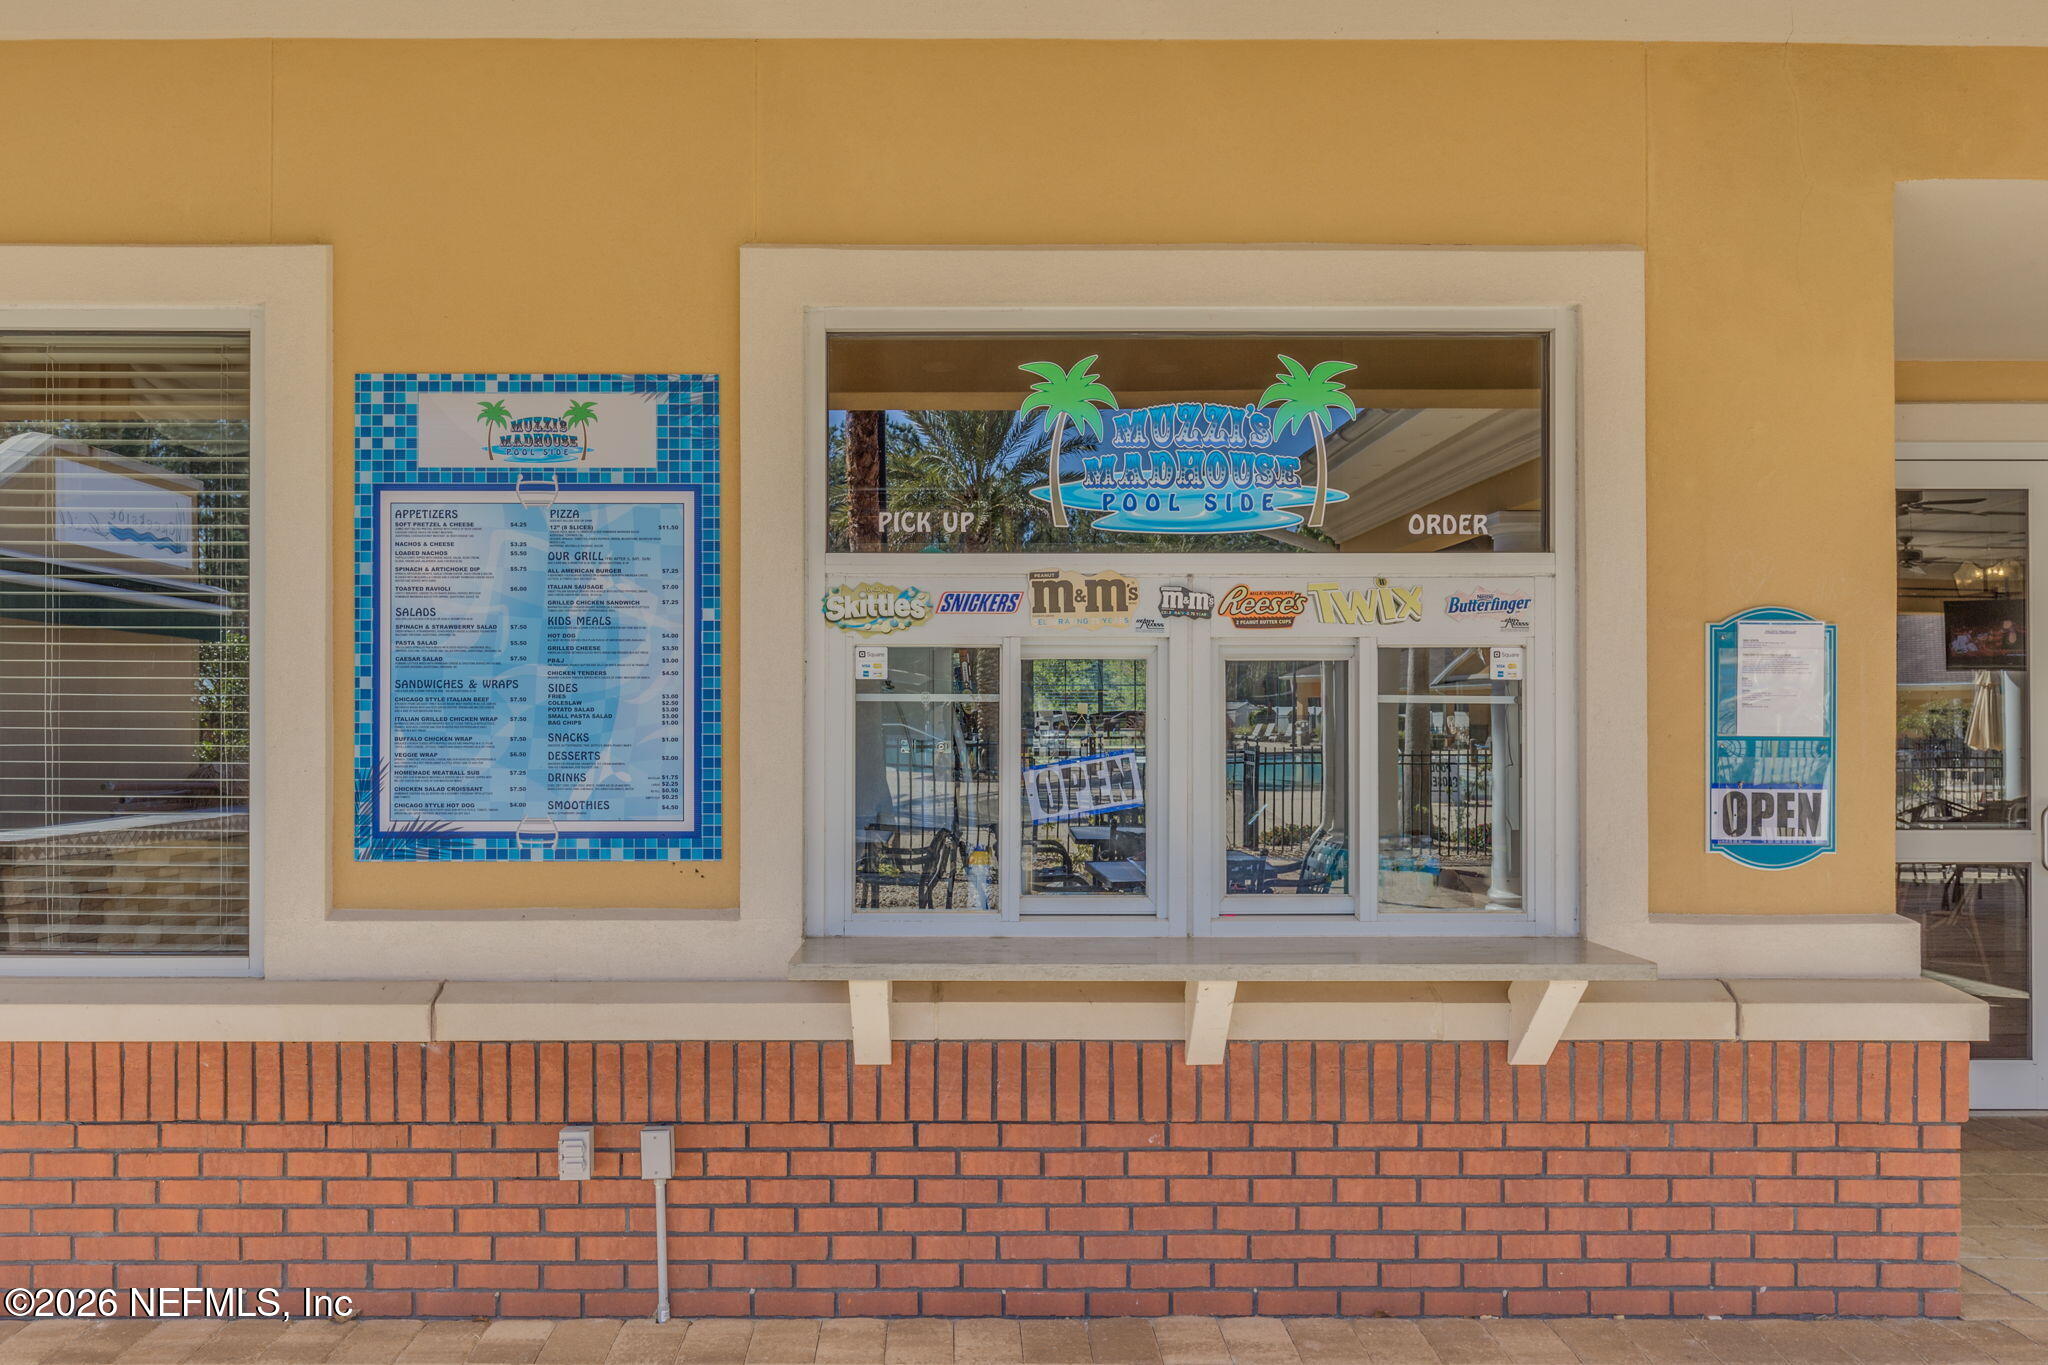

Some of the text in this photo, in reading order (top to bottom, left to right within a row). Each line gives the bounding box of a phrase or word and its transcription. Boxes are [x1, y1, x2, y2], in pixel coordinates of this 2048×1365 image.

[500, 434, 578, 447] MADHOUSE
[1083, 450, 1302, 489] MADHOUSE
[1102, 493, 1275, 512] POOL SIDE
[395, 510, 458, 518] APPETIZERS
[550, 510, 580, 518] PIZZA
[879, 512, 974, 532] PICK UP
[1408, 514, 1488, 534] ORDER
[548, 552, 603, 560] OUR GRILL
[940, 594, 1020, 612] SNICKERS
[1218, 585, 1308, 615] Reese's
[1448, 597, 1531, 614] Butterfinger
[395, 608, 436, 616] SALADS
[825, 592, 926, 622] Skittles
[547, 617, 611, 625] KIDS MEALS
[395, 680, 518, 688] SANDWICHES & WRAPS
[548, 684, 578, 692] SIDES
[548, 733, 589, 742] SNACKS
[548, 751, 601, 760] DESSERTS
[548, 773, 587, 782] DRINKS
[1036, 757, 1134, 814] OPEN
[547, 801, 610, 810] SMOOTHIES
[1723, 791, 1821, 837] OPEN
